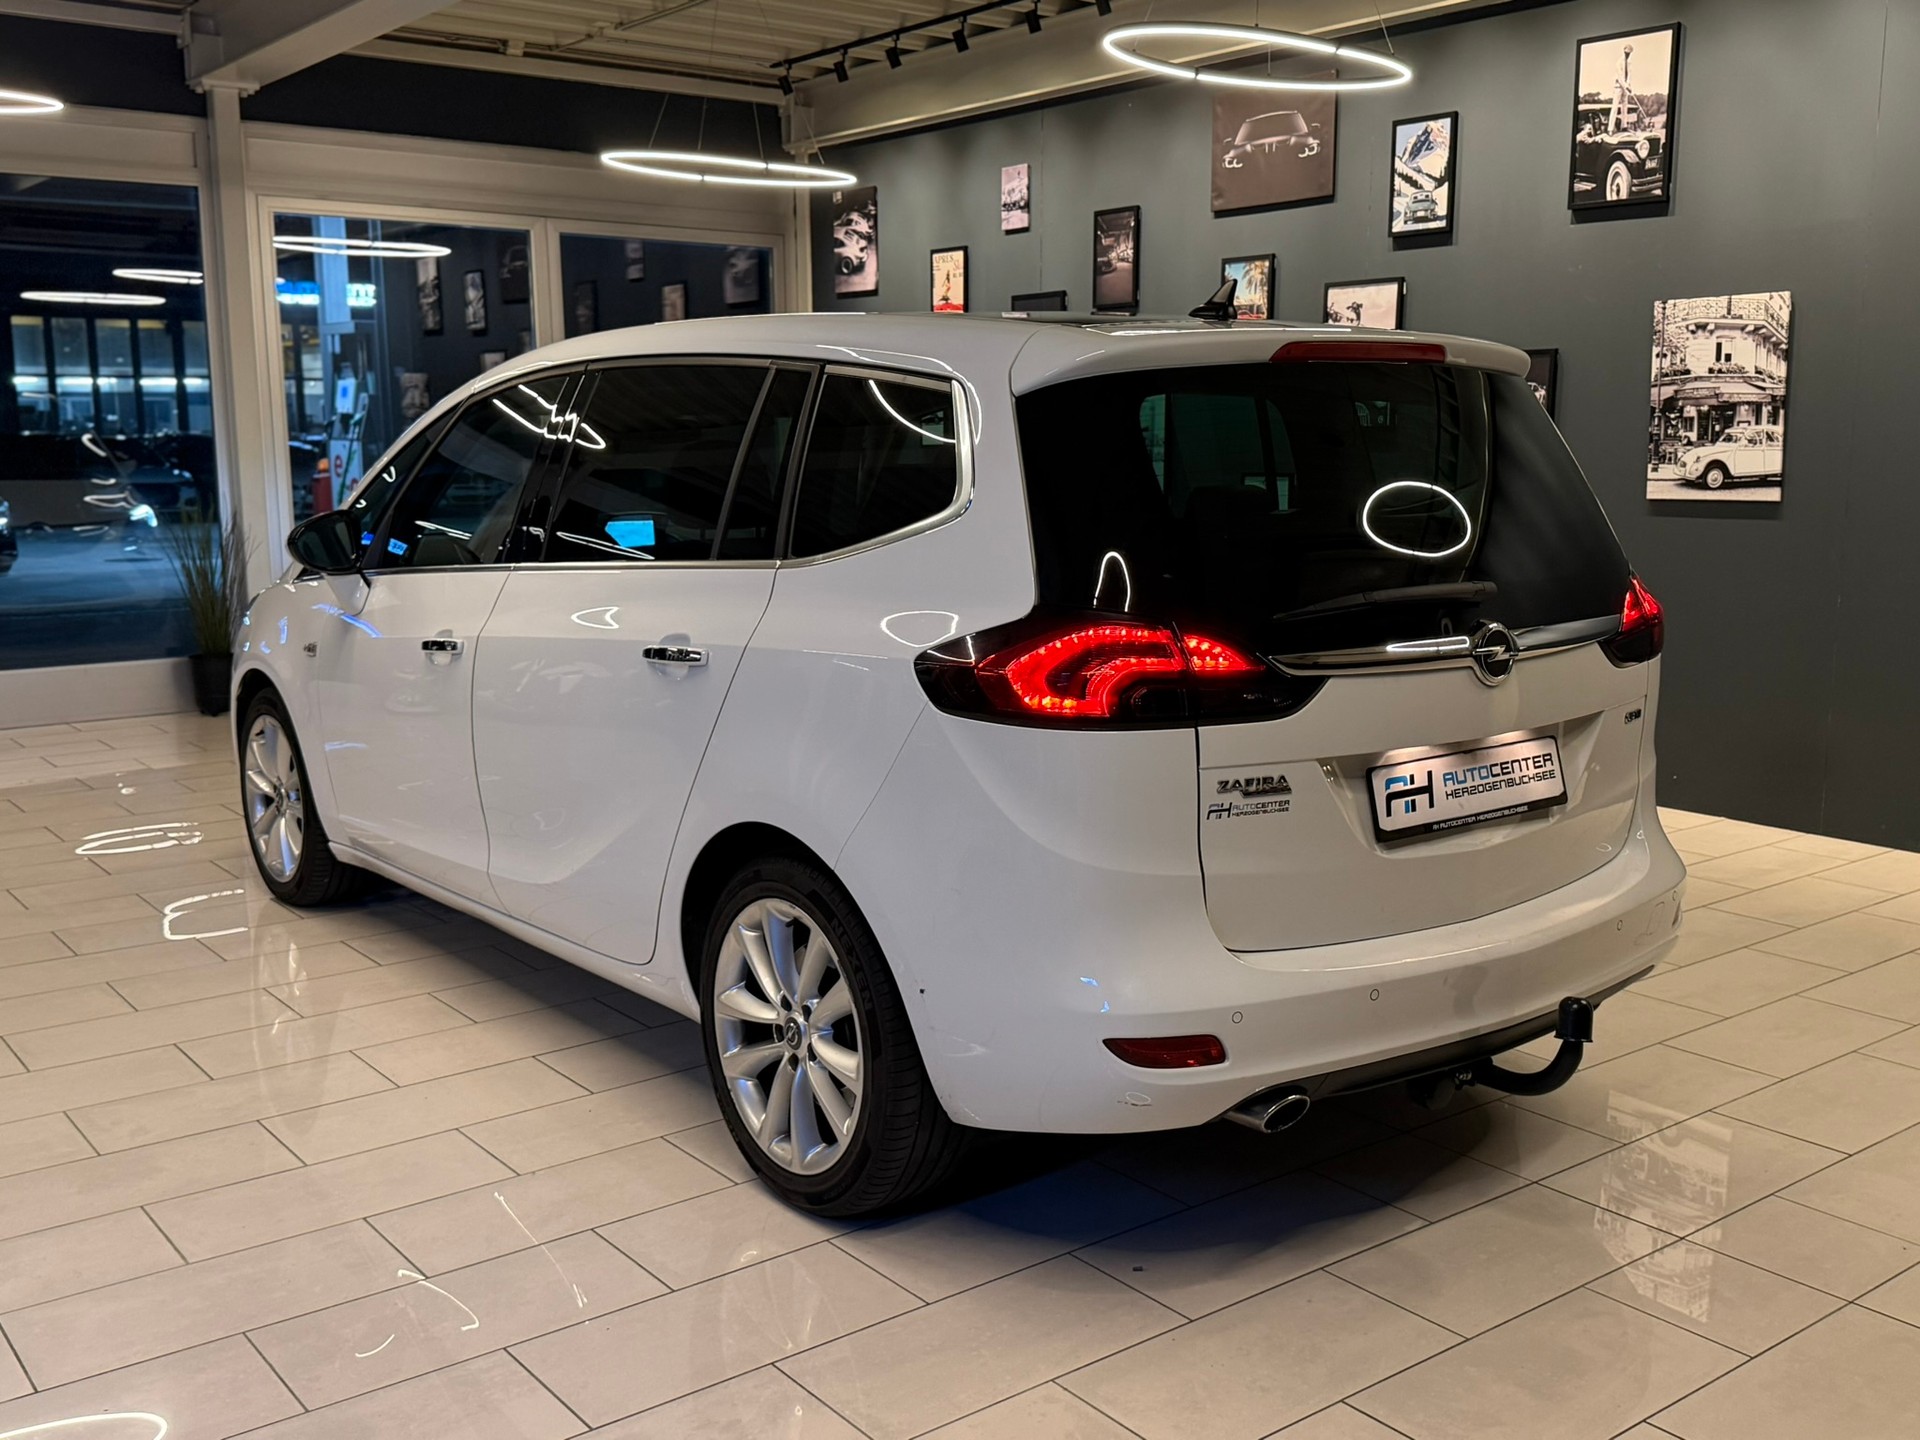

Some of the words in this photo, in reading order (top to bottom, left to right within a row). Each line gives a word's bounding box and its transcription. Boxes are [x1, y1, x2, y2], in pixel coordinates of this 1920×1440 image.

[1443, 753, 1554, 787] AUTOCENTER
[1217, 775, 1292, 796] ZAFIRA
[1445, 769, 1556, 800] HERZOGENBUCHSEE
[1232, 807, 1289, 817] HERZOGENBUCHSEE
[1233, 800, 1290, 811] AUTOCENTER
[1440, 816, 1476, 829] AUTOCENTER
[1477, 805, 1529, 821] HERZOGENBUCHSEE
[831, 916, 873, 1010] NEXEN
